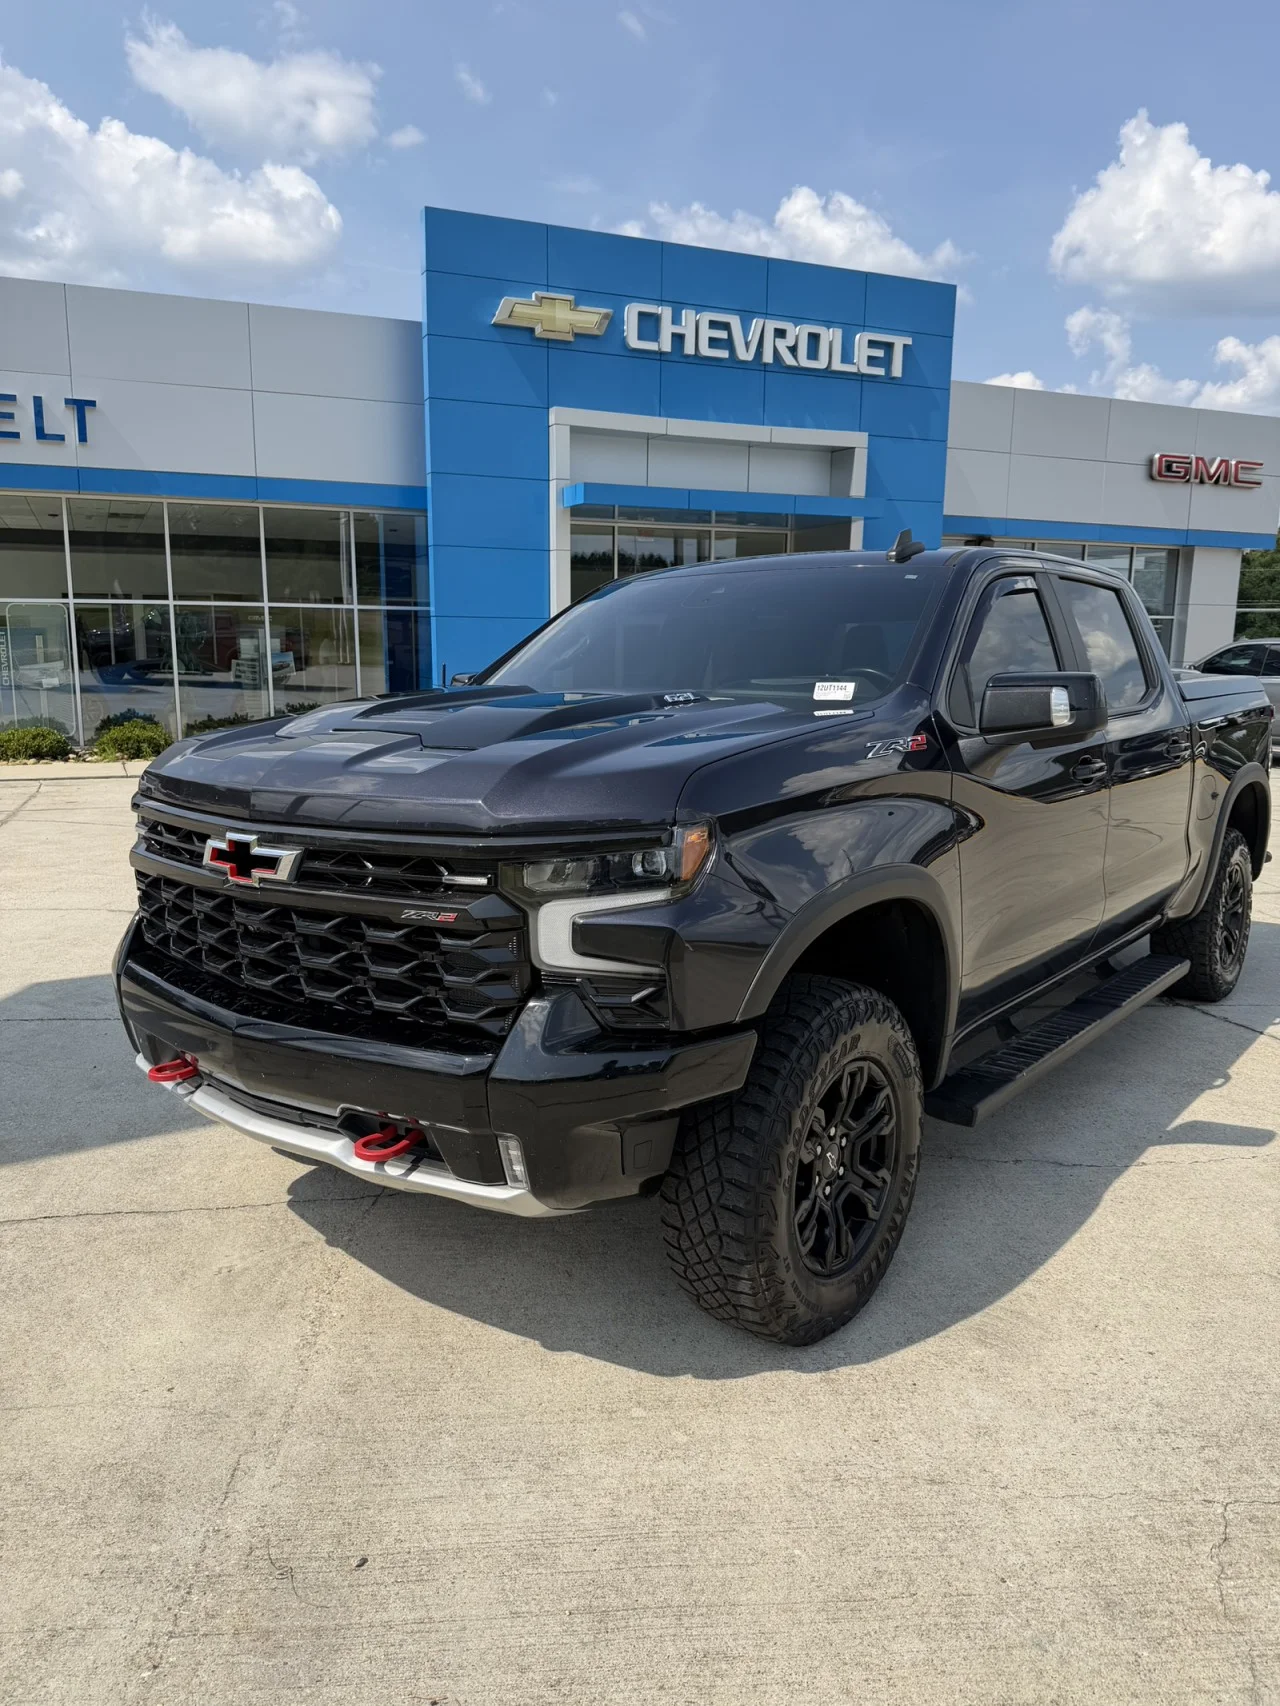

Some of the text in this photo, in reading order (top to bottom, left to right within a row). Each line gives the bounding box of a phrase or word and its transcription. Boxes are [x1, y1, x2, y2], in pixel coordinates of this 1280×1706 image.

[624, 302, 912, 378] CHEVROLET
[0, 393, 97, 443] ELT
[1152, 452, 1264, 488] GMC
[865, 735, 927, 759] ZR2
[401, 909, 458, 922] ZR2
